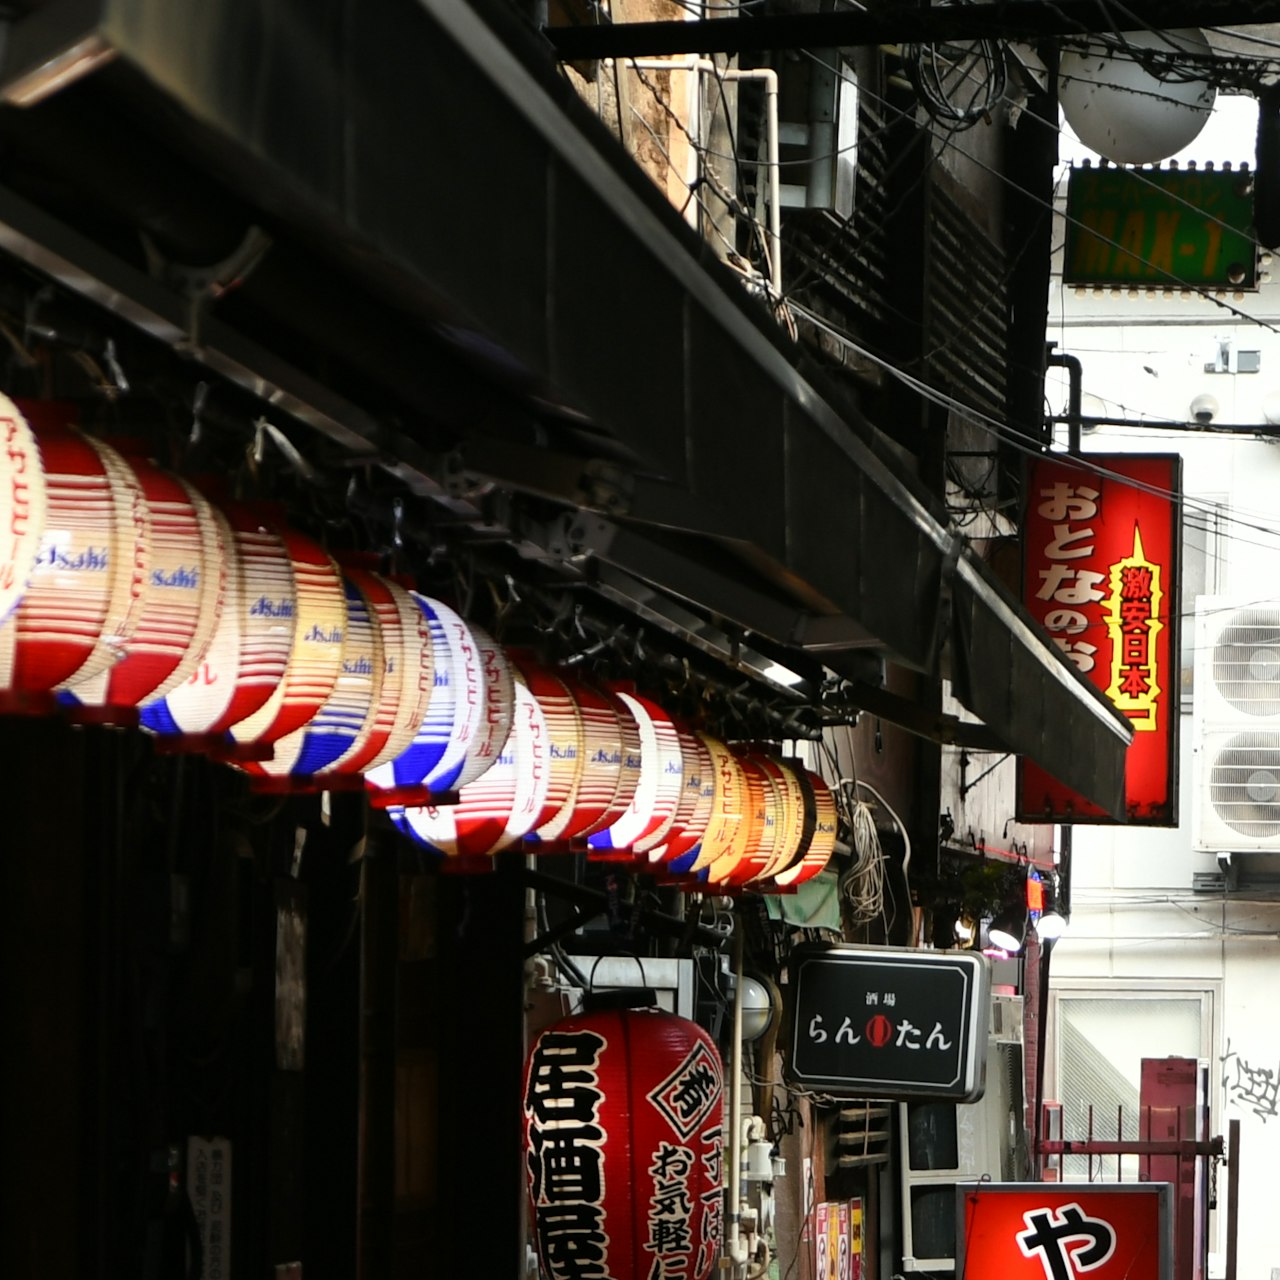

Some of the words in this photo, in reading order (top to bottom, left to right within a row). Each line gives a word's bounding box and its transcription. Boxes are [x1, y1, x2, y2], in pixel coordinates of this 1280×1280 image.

[1074, 210, 1224, 278] MAX-1
[149, 564, 200, 589] sahi
[452, 623, 477, 743] アサヒビール
[1119, 565, 1154, 719] 激安日本一
[475, 649, 501, 758] アサヒビール
[521, 702, 543, 814] アサヒビール
[809, 1014, 861, 1044] らん
[895, 1019, 952, 1050] たん
[865, 992, 896, 1007] 酒場
